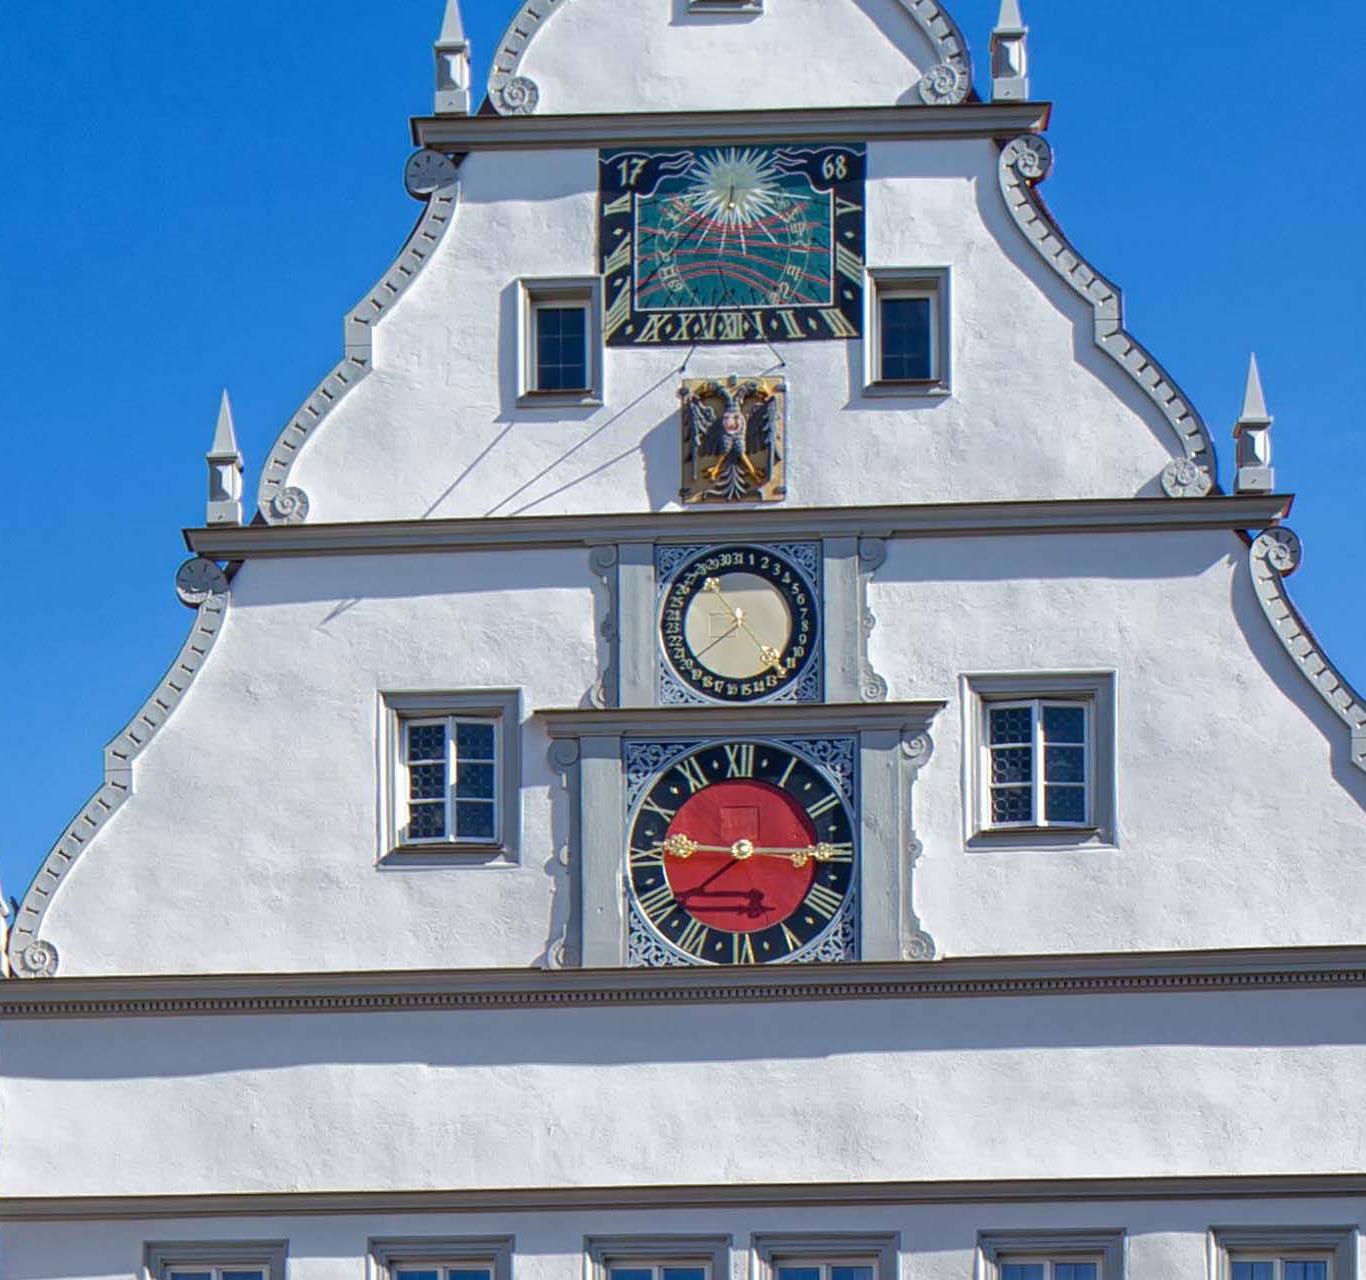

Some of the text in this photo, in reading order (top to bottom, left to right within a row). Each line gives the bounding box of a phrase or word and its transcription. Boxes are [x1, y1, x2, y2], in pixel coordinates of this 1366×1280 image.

[617, 159, 648, 188] 17
[821, 154, 847, 181] 68
[836, 196, 863, 217] V
[633, 313, 672, 343] IX
[670, 312, 697, 341] X
[718, 310, 746, 341] XII
[752, 310, 767, 340] I
[776, 310, 806, 339] II
[817, 307, 860, 338] III
[748, 554, 755, 566] 1
[761, 556, 770, 569] 2
[773, 563, 782, 576] 3
[782, 571, 793, 584] 4
[791, 583, 801, 595] 5
[797, 593, 806, 606] 6
[800, 608, 809, 621] 7
[800, 620, 809, 633] 8
[798, 633, 808, 646] 9
[724, 744, 754, 779] XII
[778, 757, 798, 787] I
[675, 756, 710, 794] XI
[642, 796, 676, 823] X
[806, 792, 839, 819] II
[779, 921, 803, 952] V
